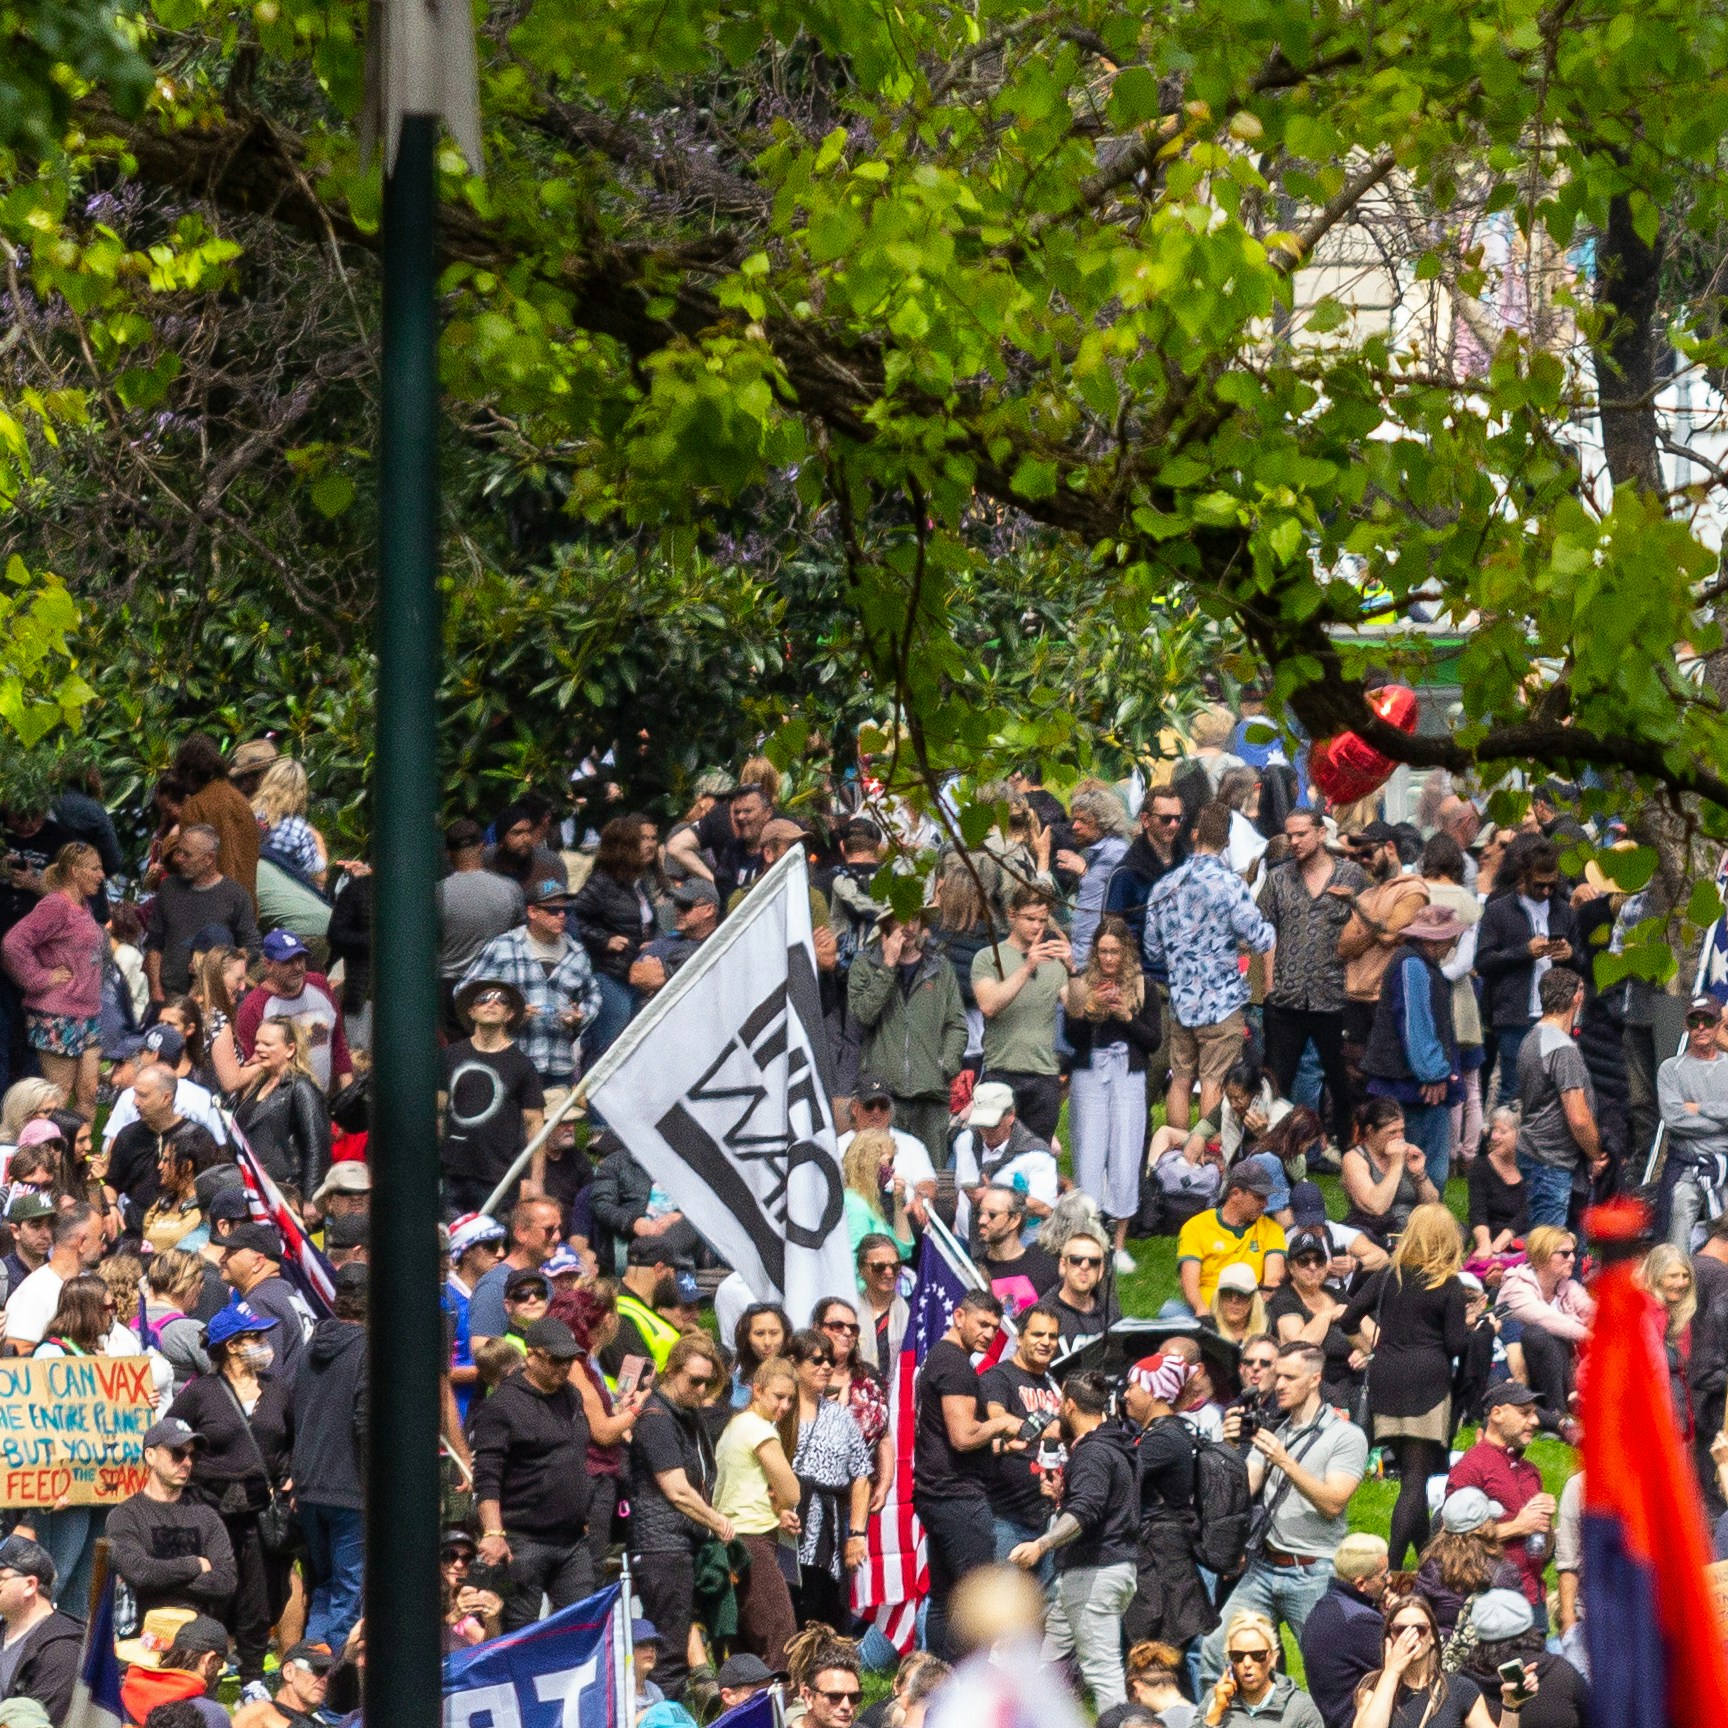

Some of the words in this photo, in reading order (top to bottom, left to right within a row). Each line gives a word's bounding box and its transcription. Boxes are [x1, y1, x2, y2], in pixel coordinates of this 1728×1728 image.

[48, 1363, 97, 1398] CAN
[94, 1362, 151, 1403] VAX
[28, 1403, 89, 1433] ENTIRE
[93, 1401, 151, 1435] PLANET
[3, 1437, 54, 1469] BUT
[7, 1467, 72, 1502] FEED
[72, 1467, 96, 1482] THE
